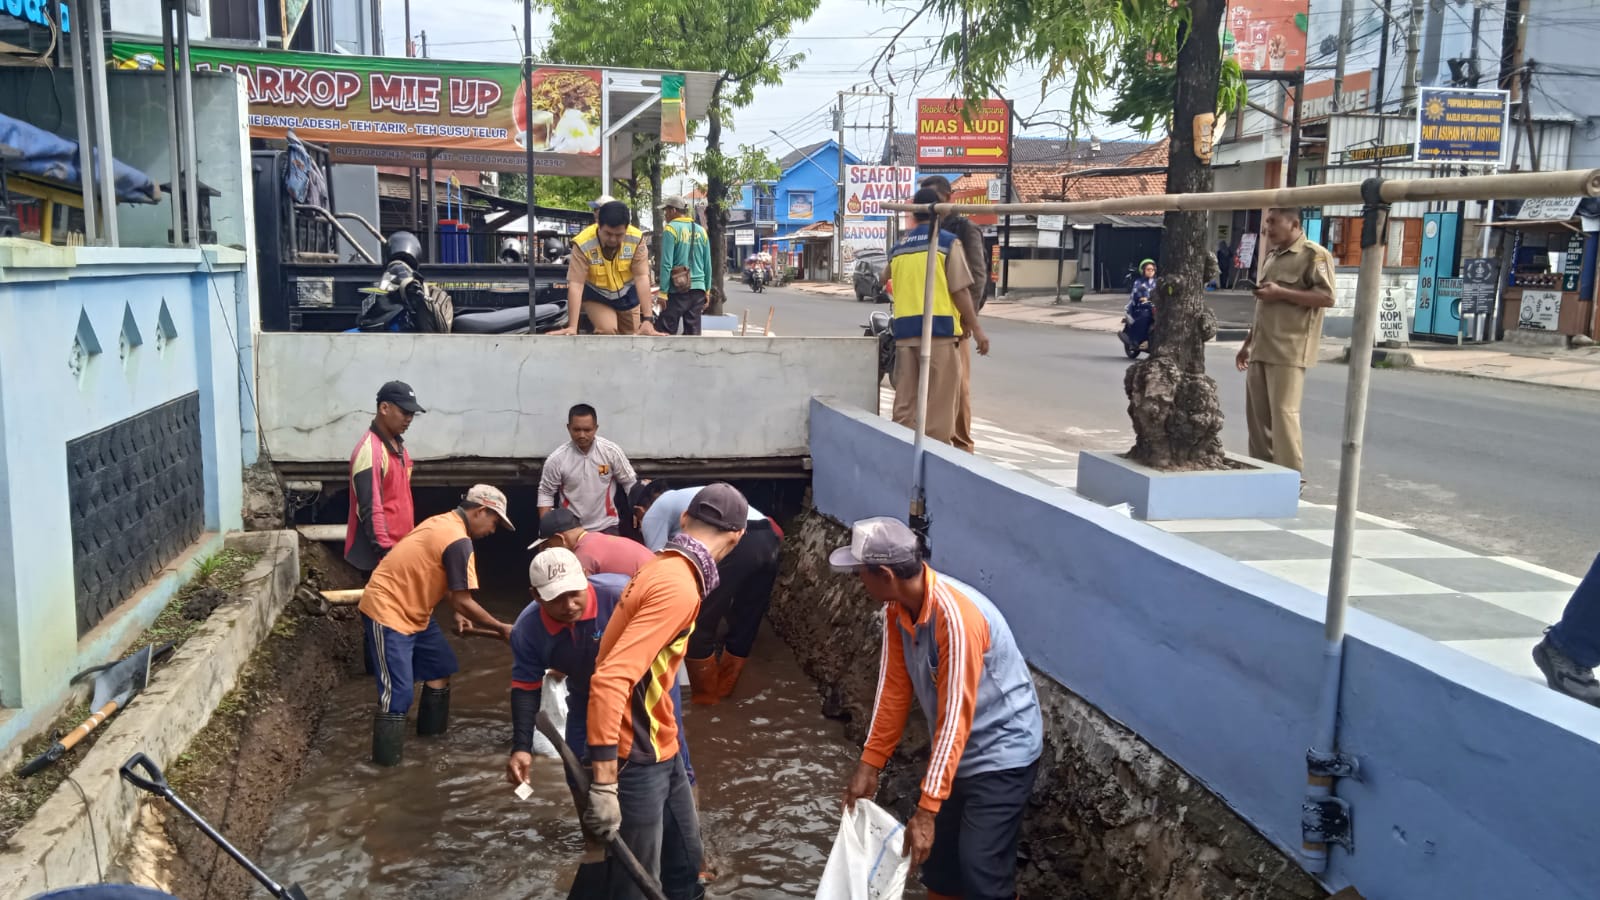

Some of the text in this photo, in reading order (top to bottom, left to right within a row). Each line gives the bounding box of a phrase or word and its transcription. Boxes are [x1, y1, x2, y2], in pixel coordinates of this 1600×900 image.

[196, 63, 501, 116] ARKOP MIE UP
[247, 115, 261, 126] IE
[263, 115, 340, 130] BANGLADESH
[350, 120, 371, 132] TEH
[374, 122, 406, 134] TARIK
[415, 124, 439, 136] TEH
[440, 126, 470, 138] SUSU
[471, 127, 507, 138] TELUR
[920, 119, 958, 134] MAS
[850, 166, 912, 183] SEAFOOD
[862, 183, 911, 200] AYAM
[844, 226, 887, 240] EAFOOD
[1424, 256, 1434, 268] 17
[1422, 277, 1432, 288] 08
[1419, 298, 1430, 309] 25
[1380, 311, 1402, 321] KOPI
